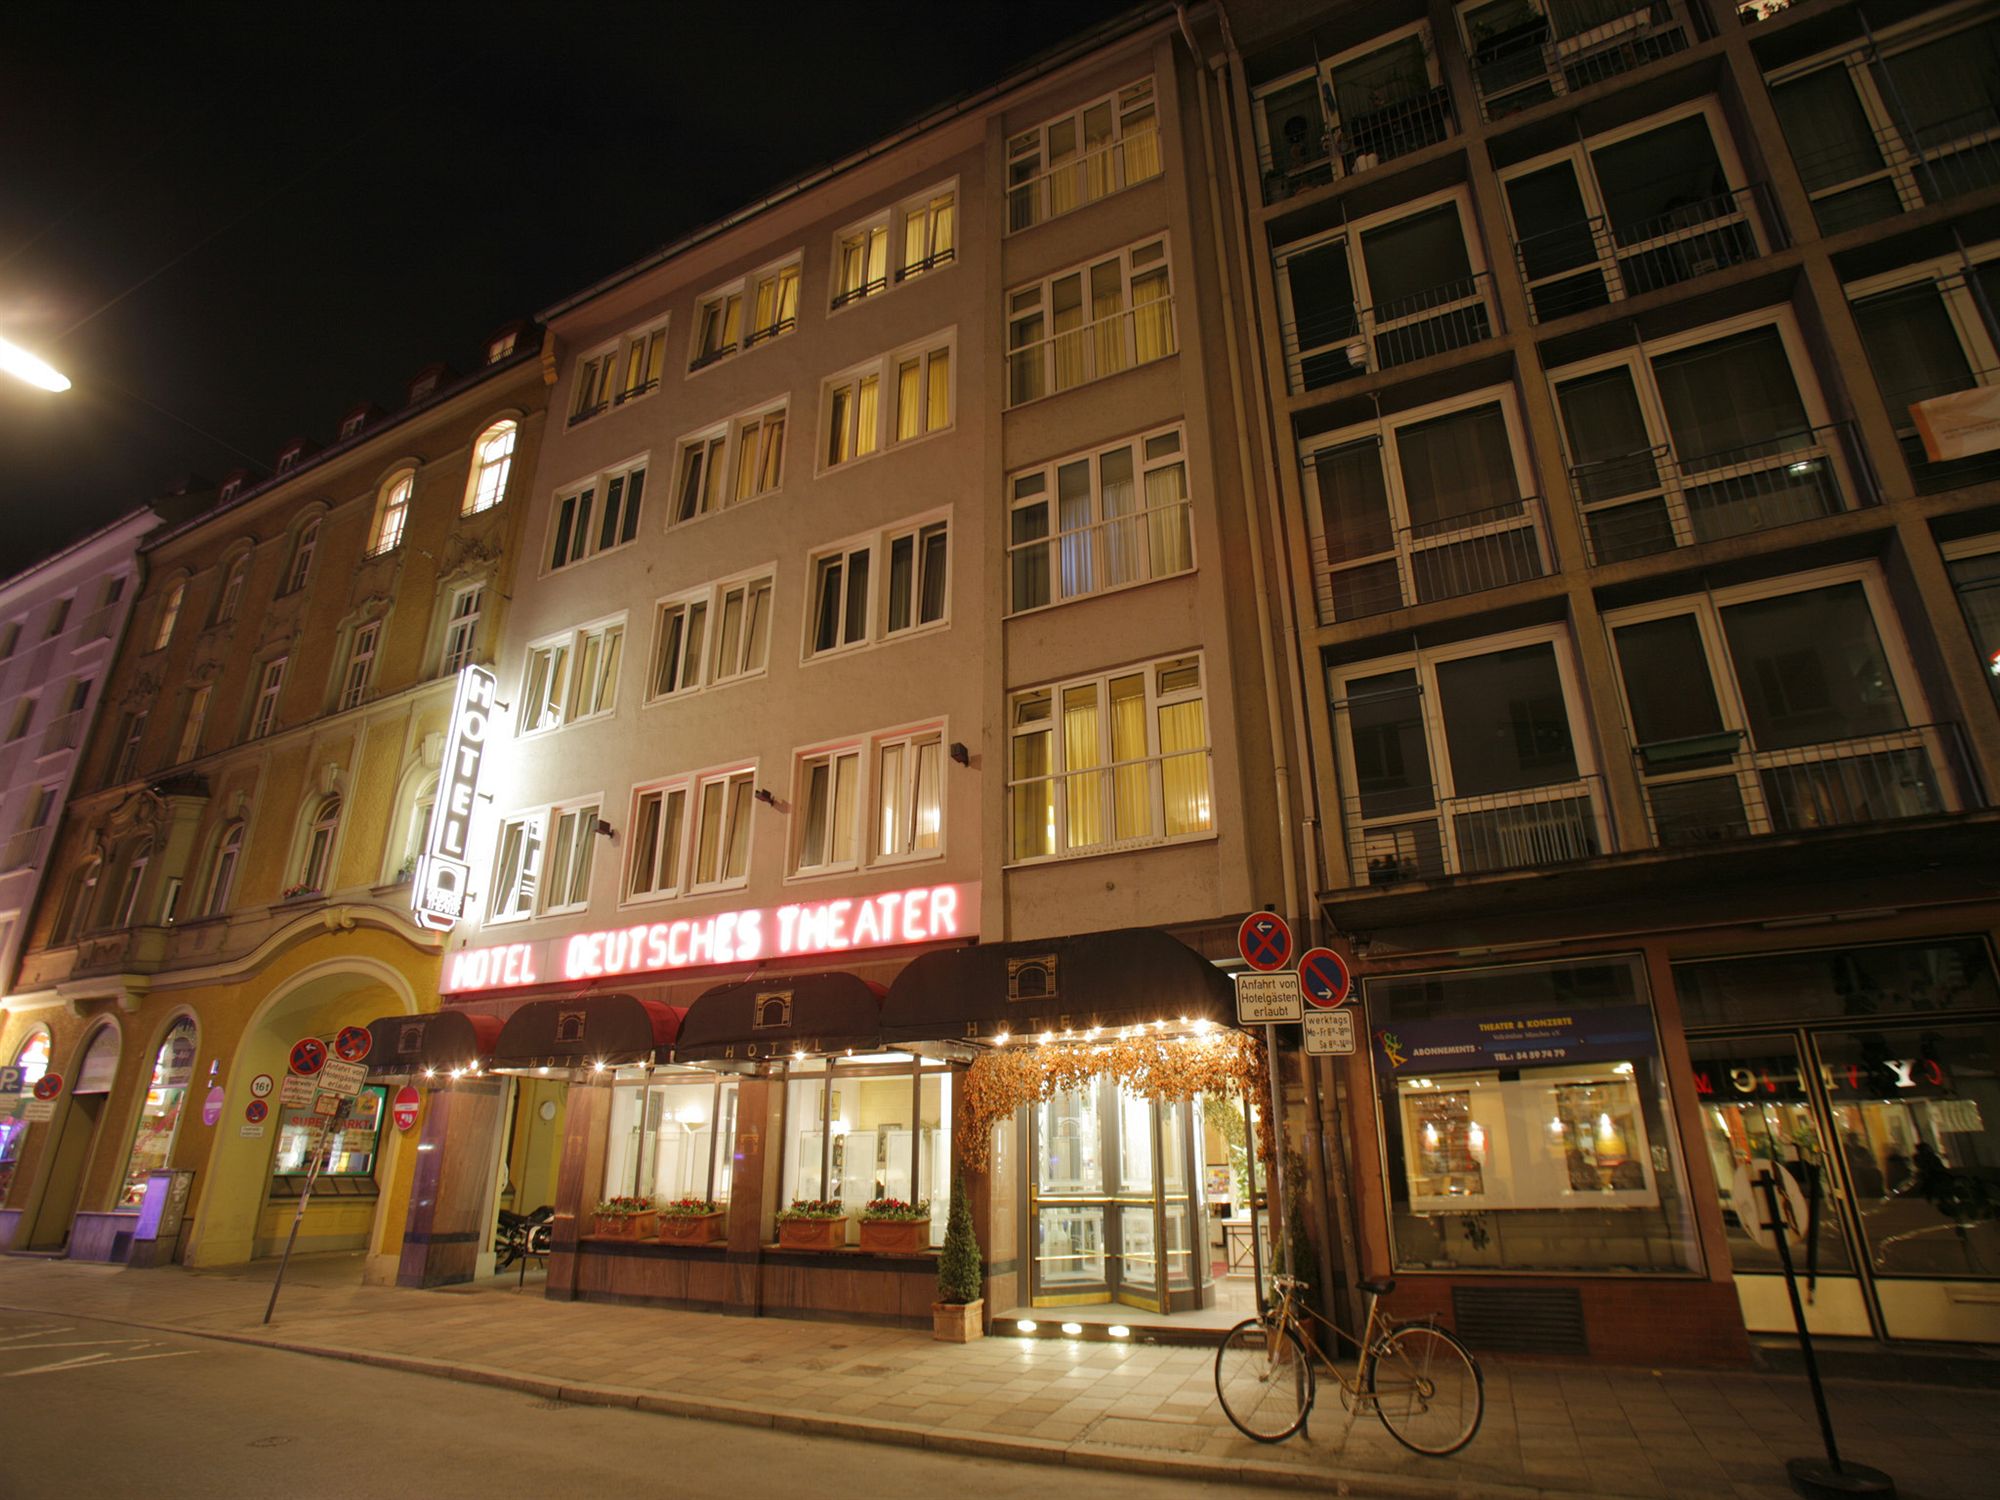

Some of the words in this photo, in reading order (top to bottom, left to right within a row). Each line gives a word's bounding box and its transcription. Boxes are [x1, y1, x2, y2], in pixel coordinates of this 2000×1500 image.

[444, 673, 494, 855] HOTEL
[451, 943, 536, 991] HOTEL
[565, 908, 764, 980] DEUTSCHES
[776, 885, 959, 953] THEATER
[1241, 979, 1276, 990] Anfahrt
[1279, 980, 1297, 989] von
[1241, 992, 1298, 1005] Hotelgästen
[1253, 1006, 1289, 1017] erlaubt
[1307, 1015, 1349, 1027] werktags
[1479, 1022, 1514, 1032] THEATER
[1526, 1017, 1572, 1028] KONZERTE
[724, 1034, 823, 1057] HOTEL
[1412, 1044, 1476, 1057] ABONNEMENTS
[528, 1055, 590, 1068] HOTE
[291, 1116, 370, 1129] SUPEARKT
